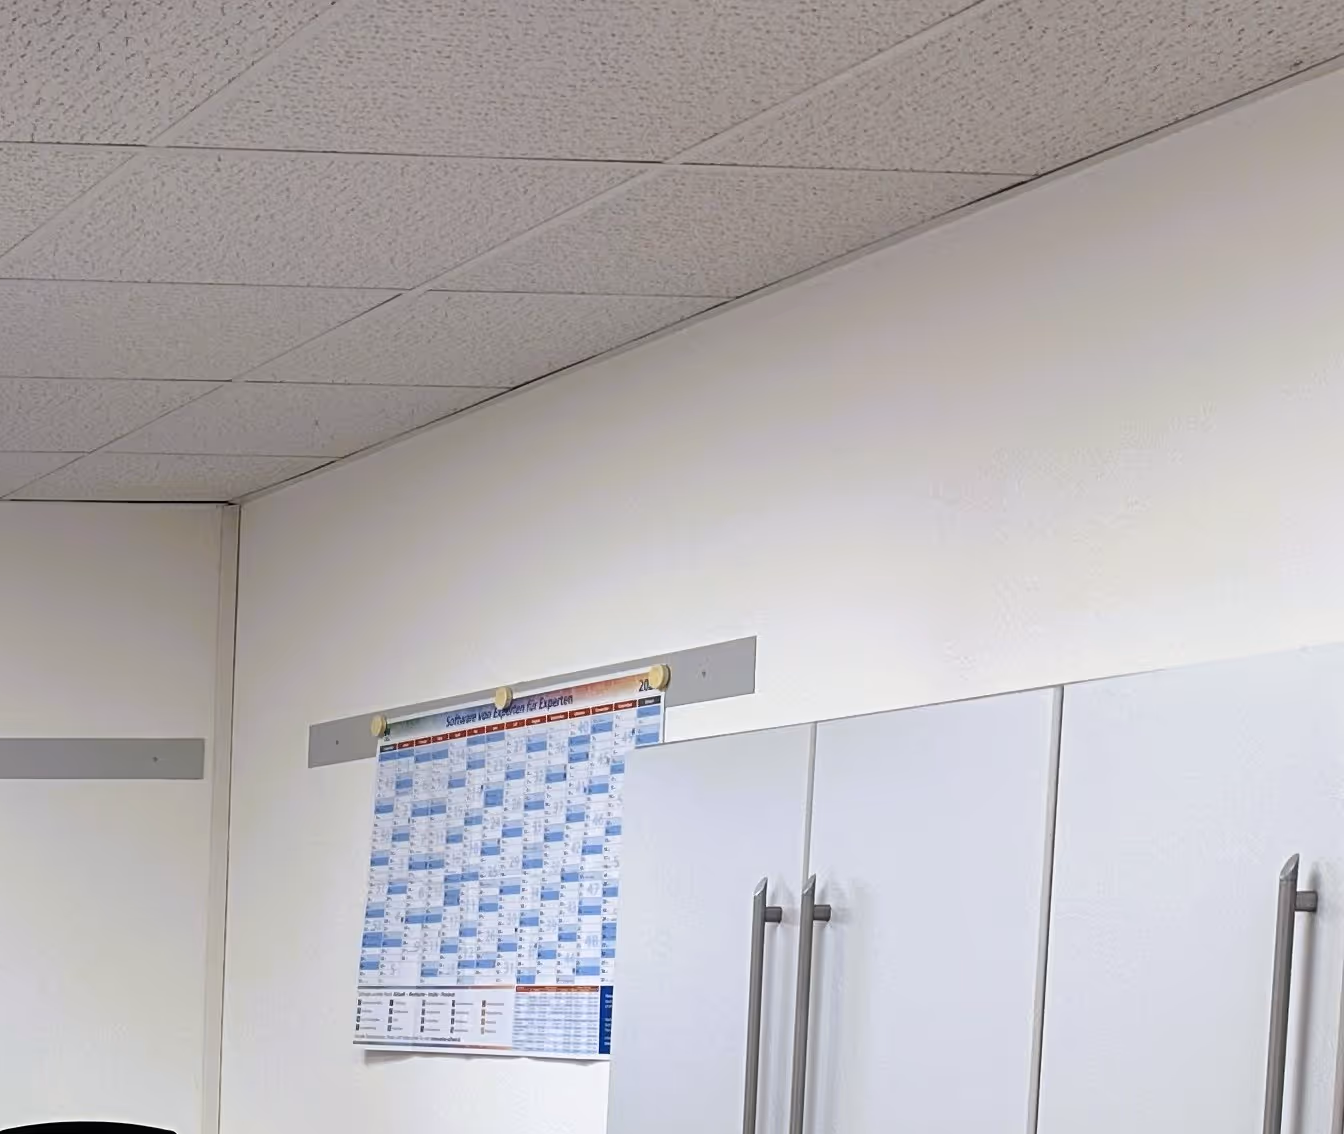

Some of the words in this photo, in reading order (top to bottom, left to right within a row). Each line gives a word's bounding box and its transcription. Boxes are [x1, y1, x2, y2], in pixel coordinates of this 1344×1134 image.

[446, 712, 476, 727] Software
[478, 712, 492, 721] von
[493, 704, 525, 720] Experten
[527, 702, 537, 712] für
[538, 694, 573, 711] Experten
